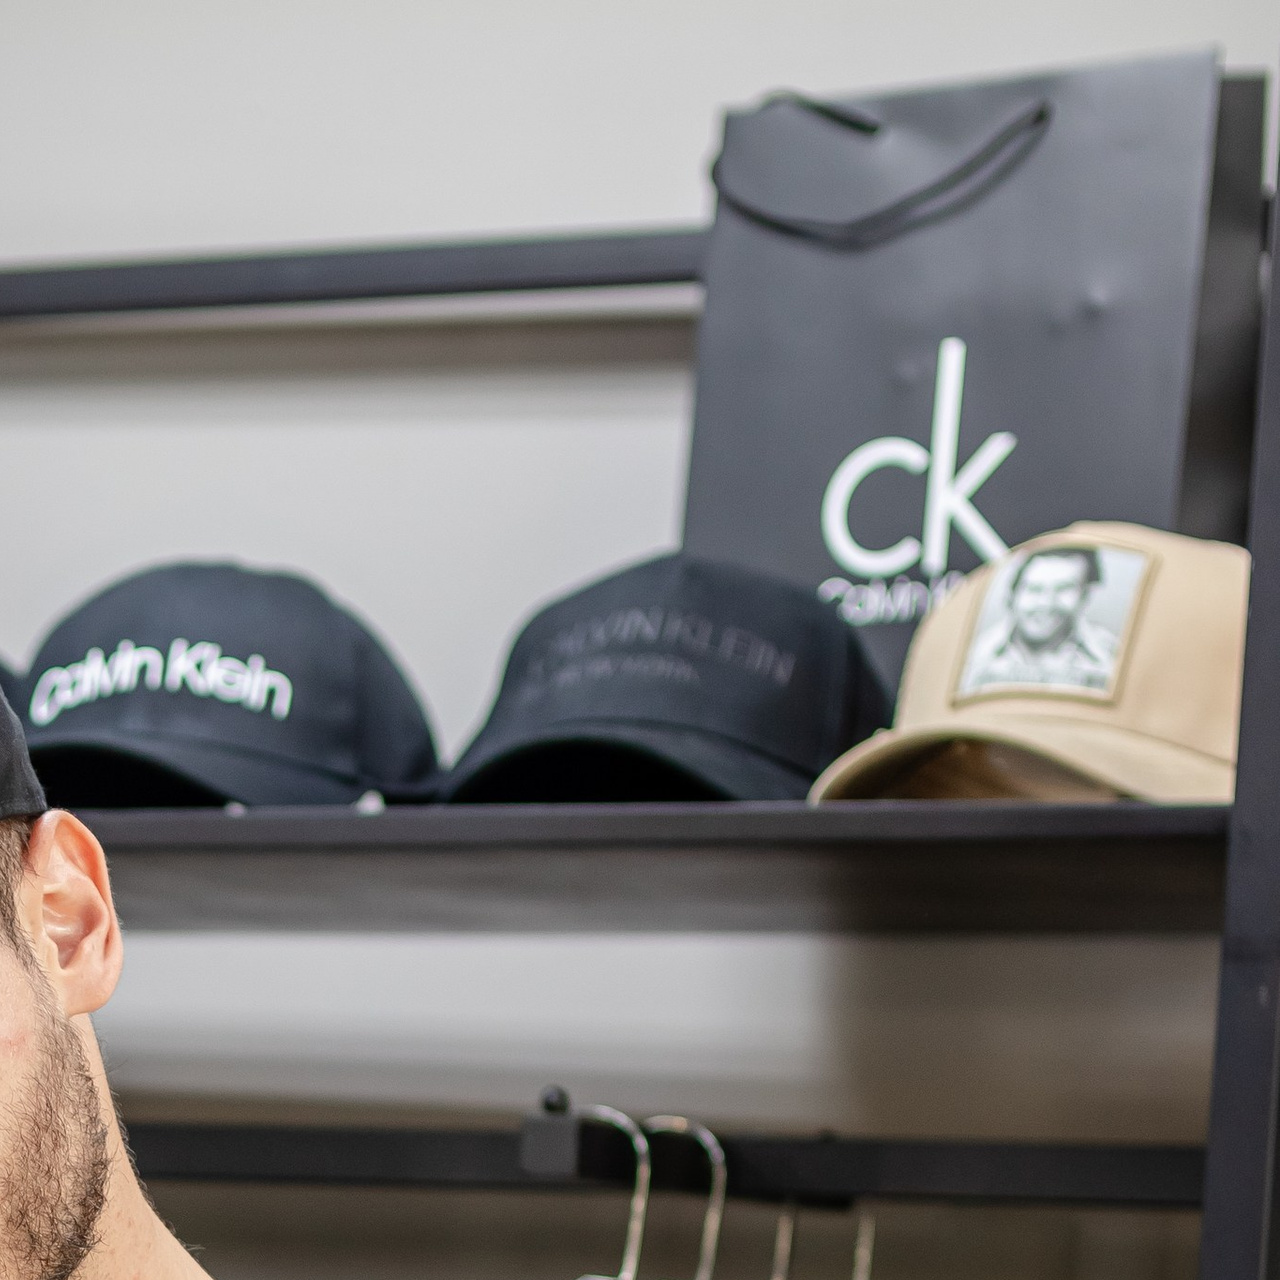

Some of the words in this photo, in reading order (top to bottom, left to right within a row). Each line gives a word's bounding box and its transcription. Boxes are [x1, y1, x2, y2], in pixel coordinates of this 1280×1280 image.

[821, 336, 1018, 578] ck
[29, 639, 164, 726] Calvin
[165, 637, 294, 720] Klein
